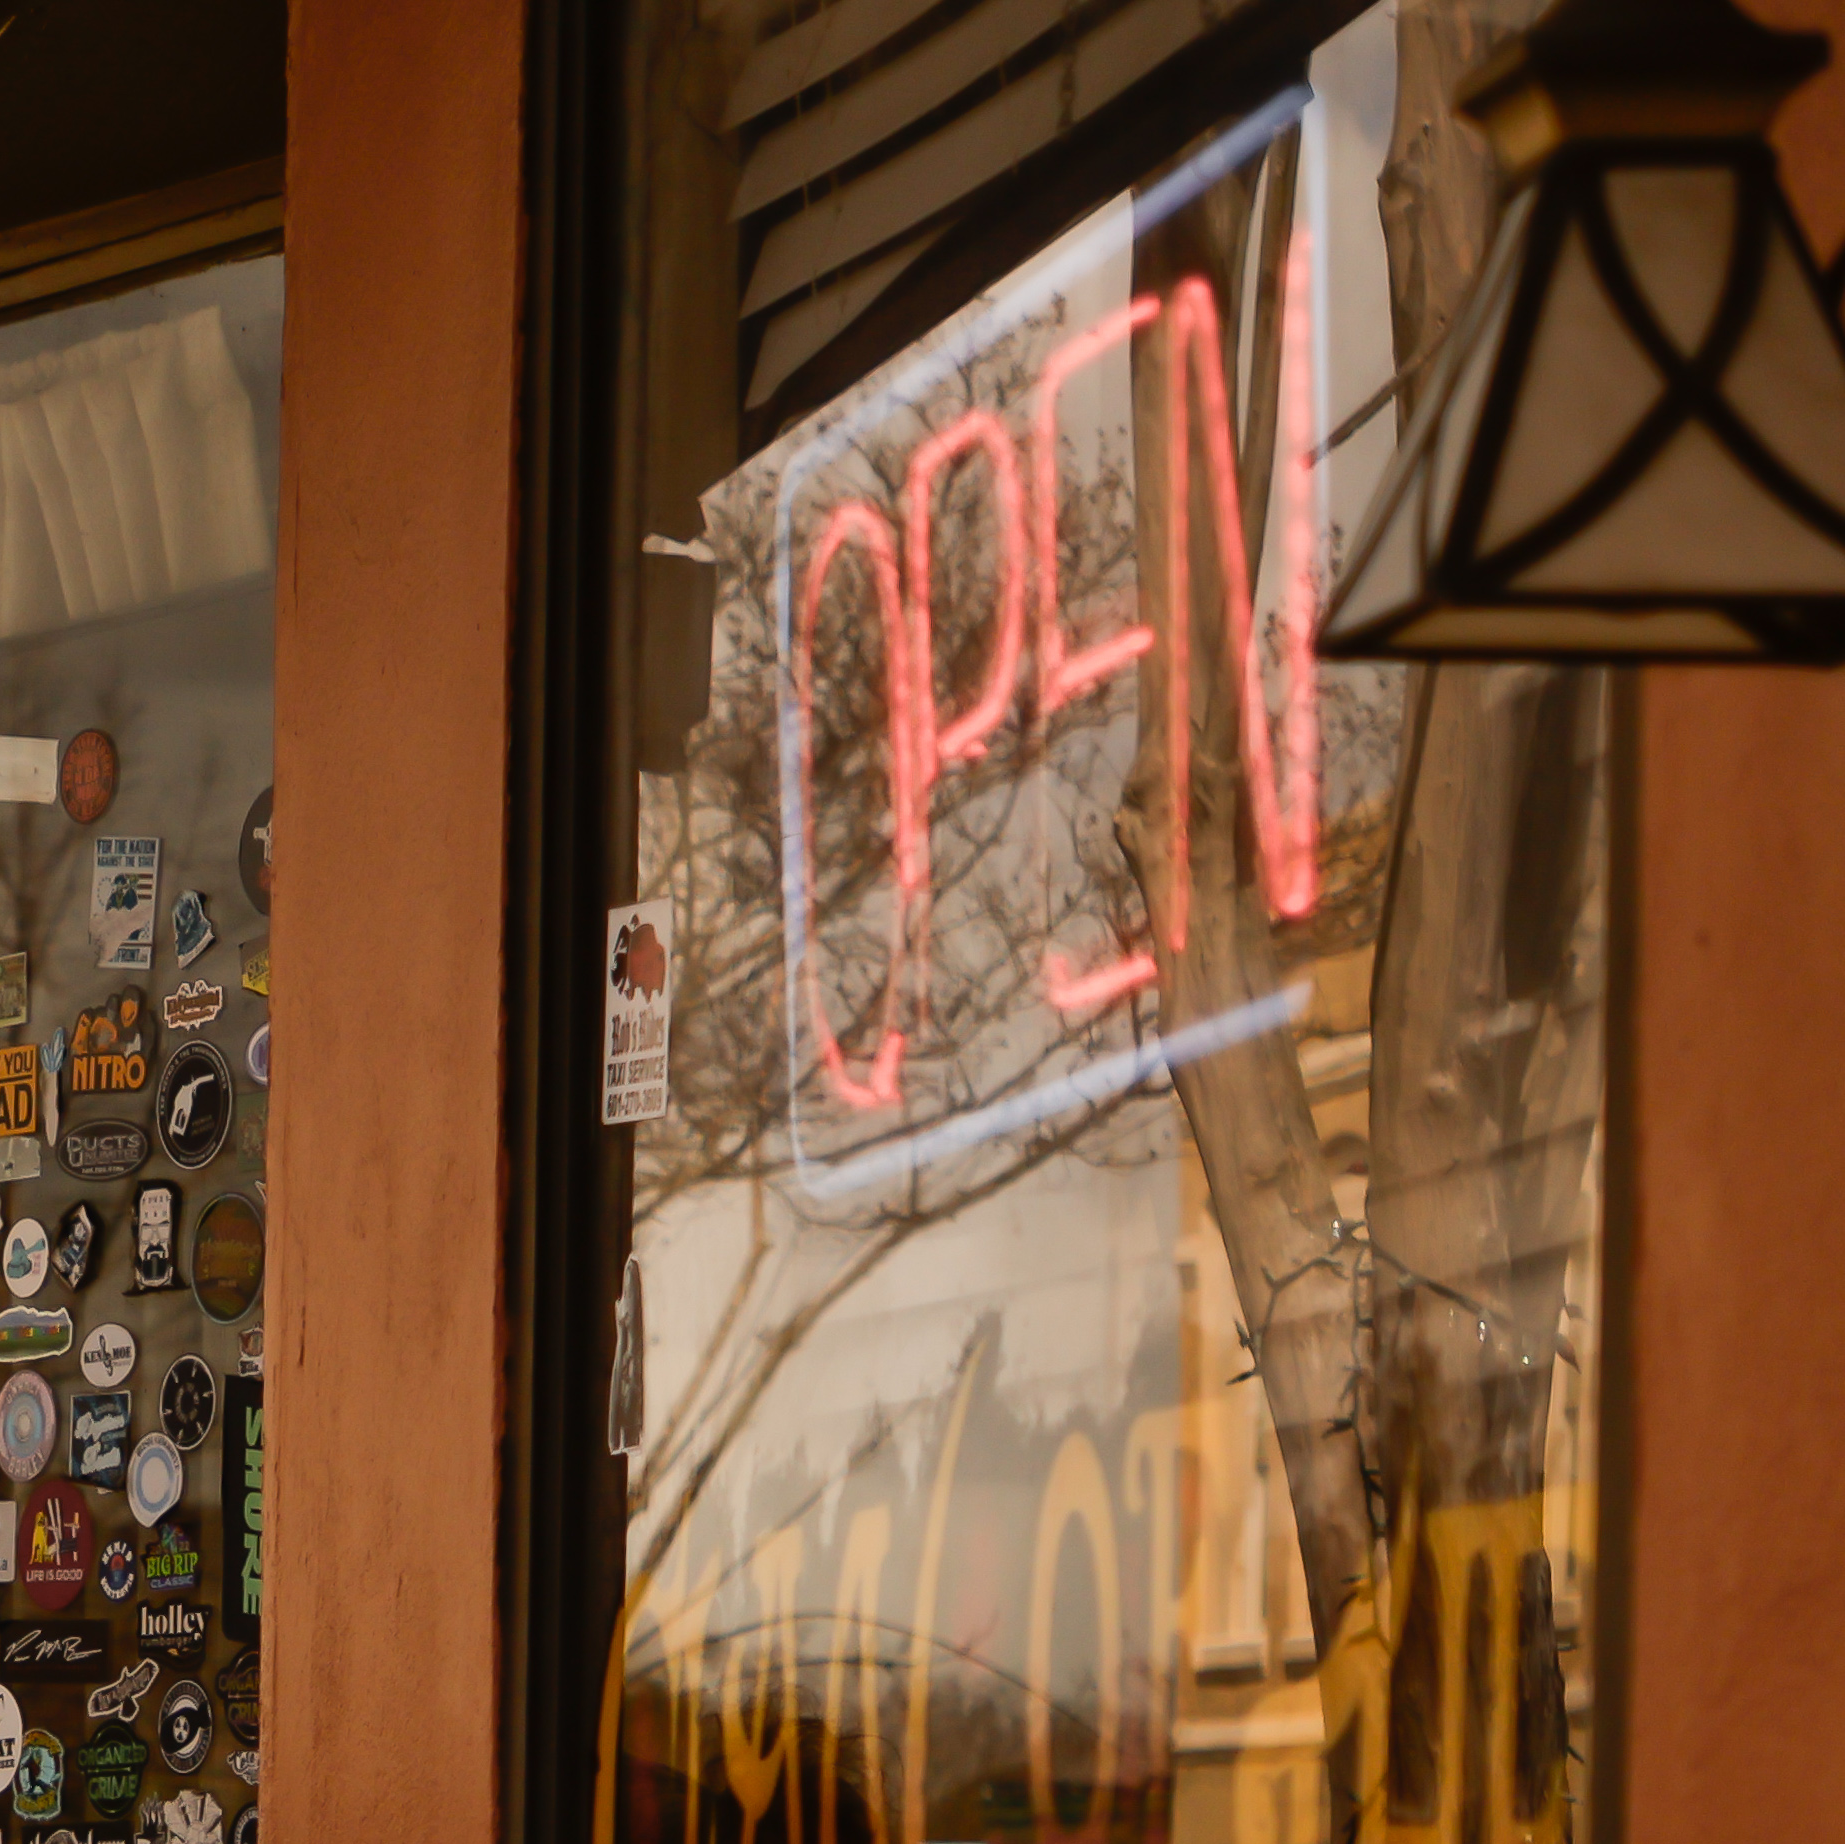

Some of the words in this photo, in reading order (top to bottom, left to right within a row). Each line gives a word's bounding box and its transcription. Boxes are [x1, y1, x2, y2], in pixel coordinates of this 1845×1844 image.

[798, 225, 1314, 1112] OPEN
[6, 1051, 34, 1076] YOU
[72, 1054, 147, 1091] NITRO
[607, 1062, 627, 1088] TAXI
[628, 1056, 665, 1084] SERVICE
[146, 1555, 171, 1578] BIG
[173, 1552, 199, 1575] RIP
[149, 1575, 194, 1589] CLASSIC
[141, 1602, 205, 1640] holley
[88, 1774, 137, 1800] CRIME
